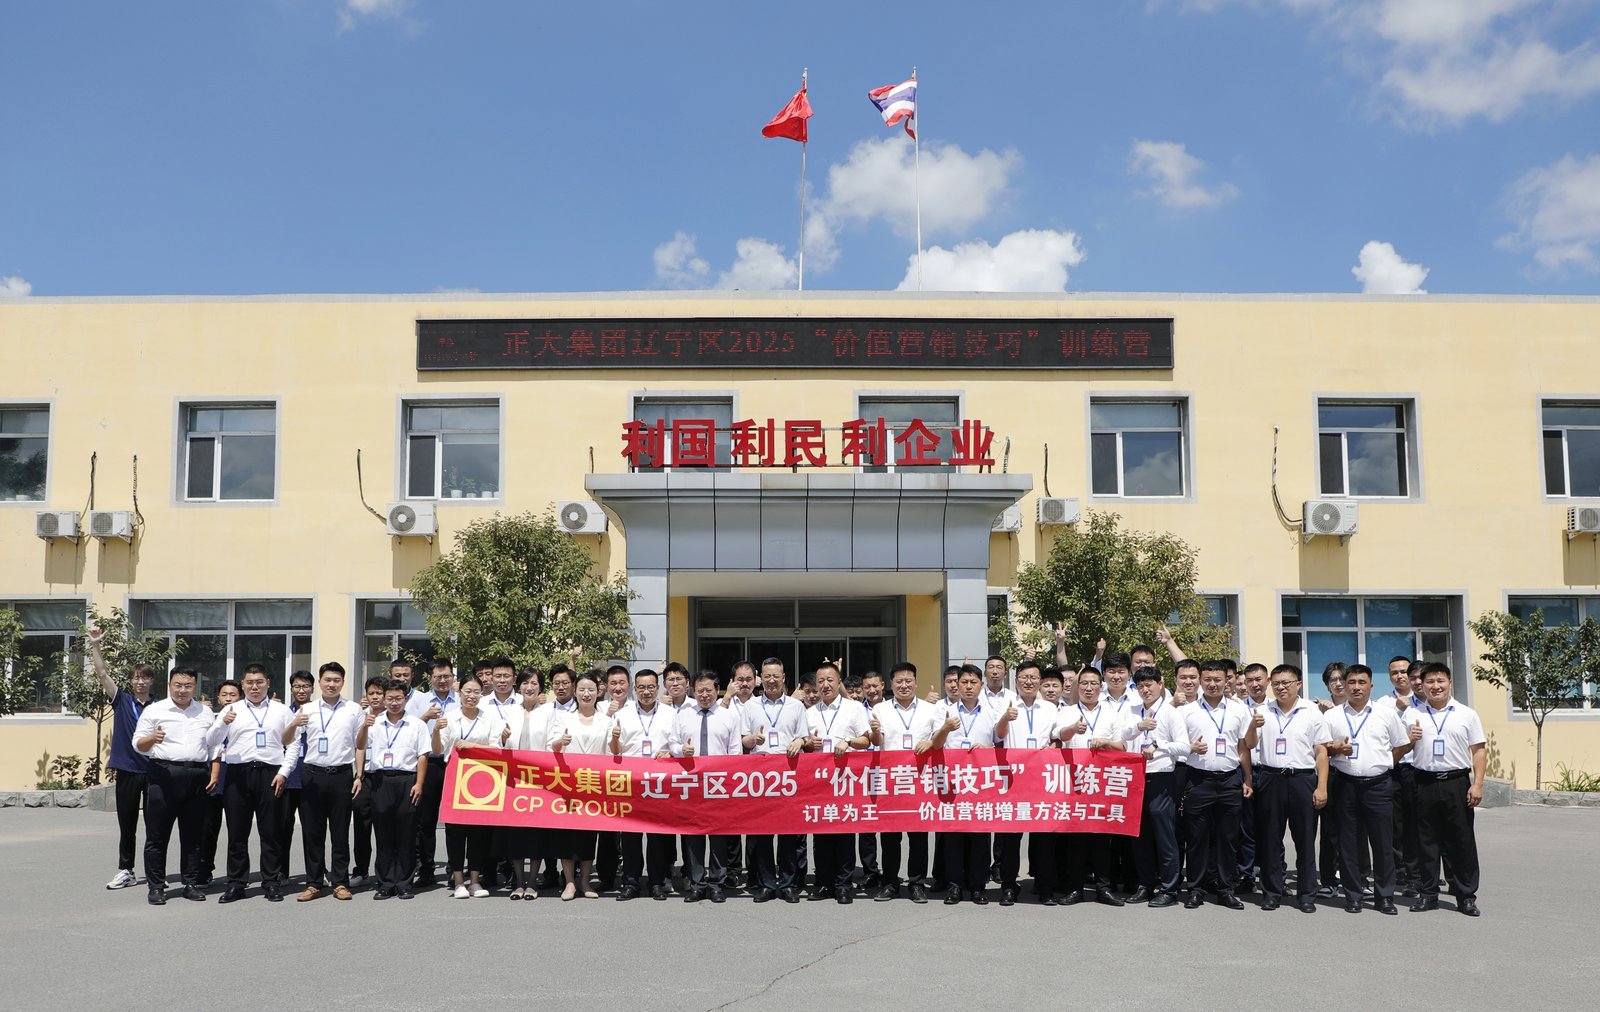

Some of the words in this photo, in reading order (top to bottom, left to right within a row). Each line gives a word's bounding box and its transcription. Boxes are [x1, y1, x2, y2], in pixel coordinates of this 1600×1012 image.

[621, 418, 995, 467] 利国利民利企业
[515, 764, 633, 796] 正大集团
[513, 796, 544, 813] CP
[551, 798, 633, 818] GROUP
[802, 802, 1126, 824] 订单为王——价值营销增量方法与工具
